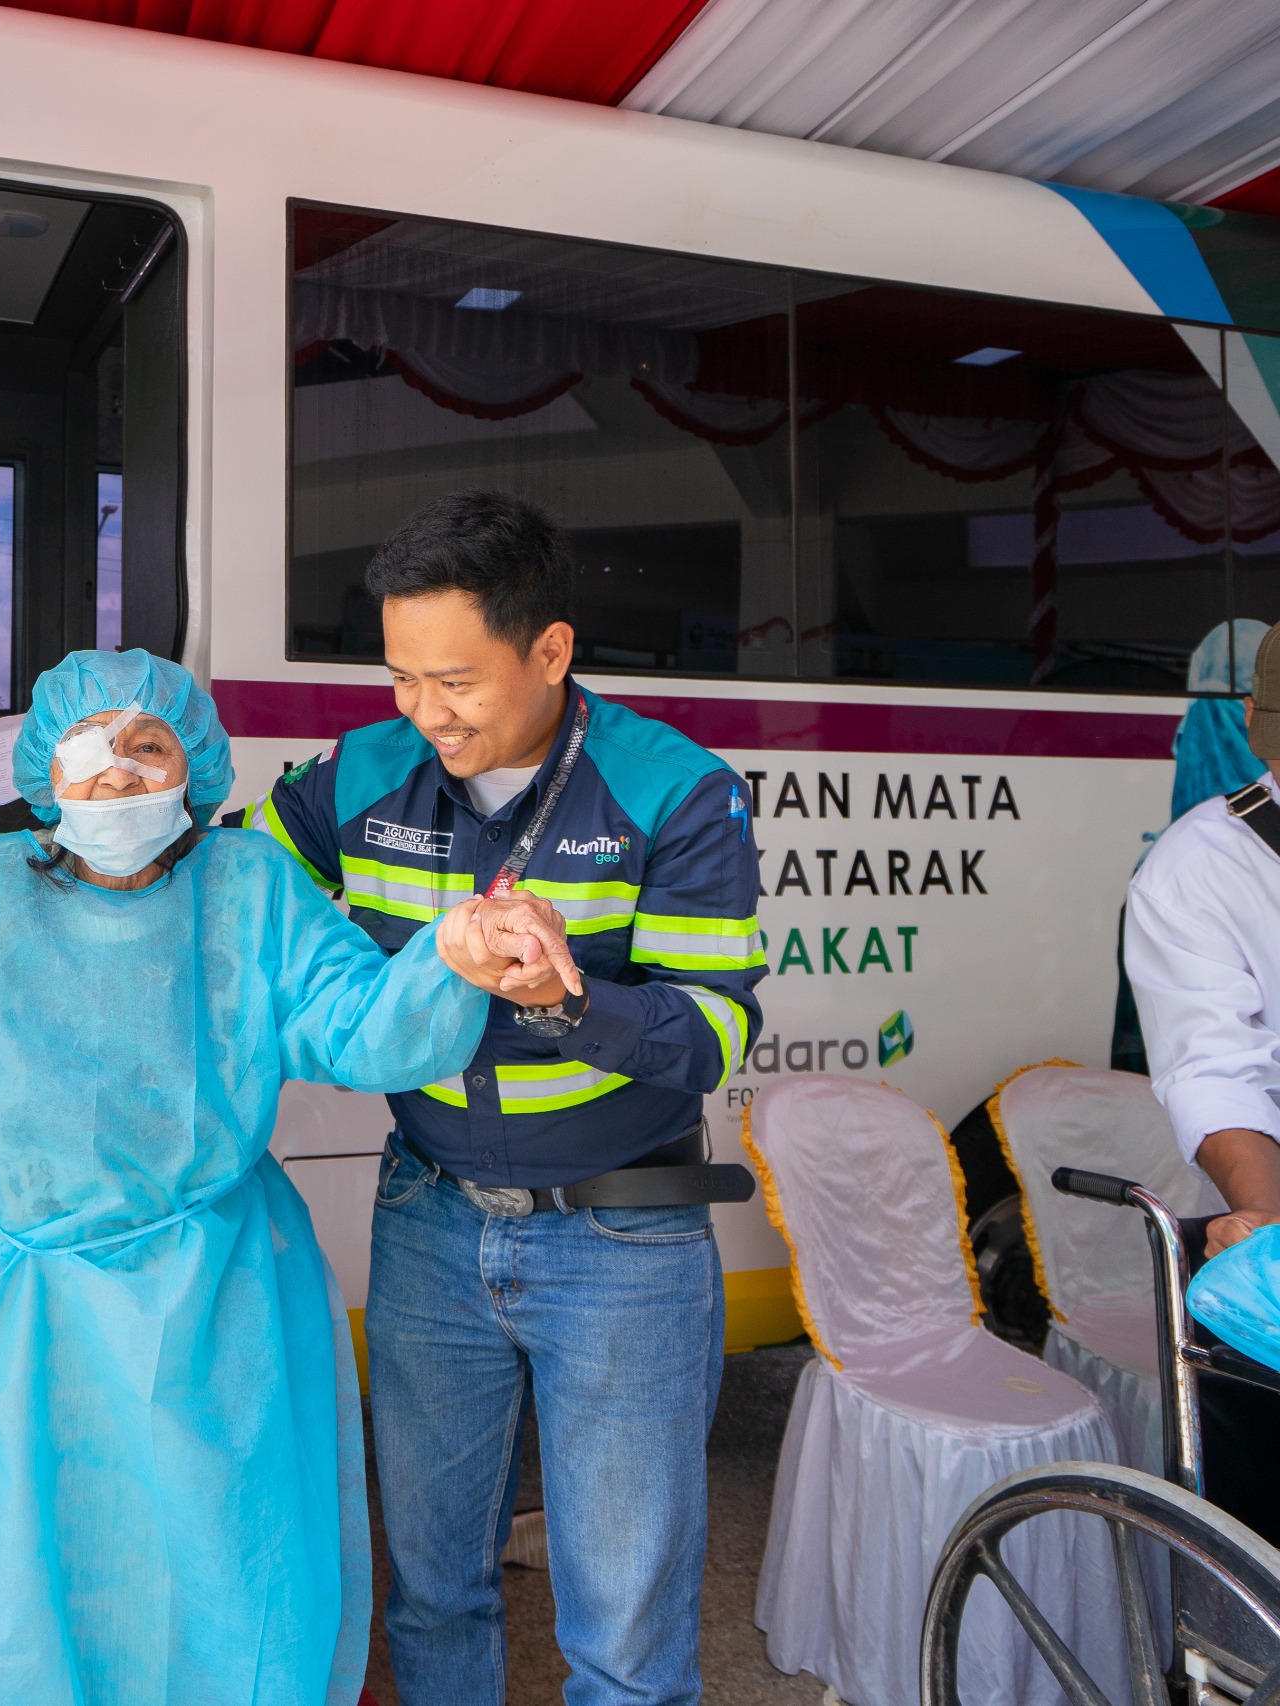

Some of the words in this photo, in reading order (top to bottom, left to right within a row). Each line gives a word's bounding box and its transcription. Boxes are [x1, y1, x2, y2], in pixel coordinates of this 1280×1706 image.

[873, 773, 1021, 820] MATA
[384, 826, 422, 842] AGUNG
[423, 834, 431, 843] F
[595, 853, 620, 865] geo
[762, 926, 919, 976] AKAT
[727, 1087, 760, 1109] FO
